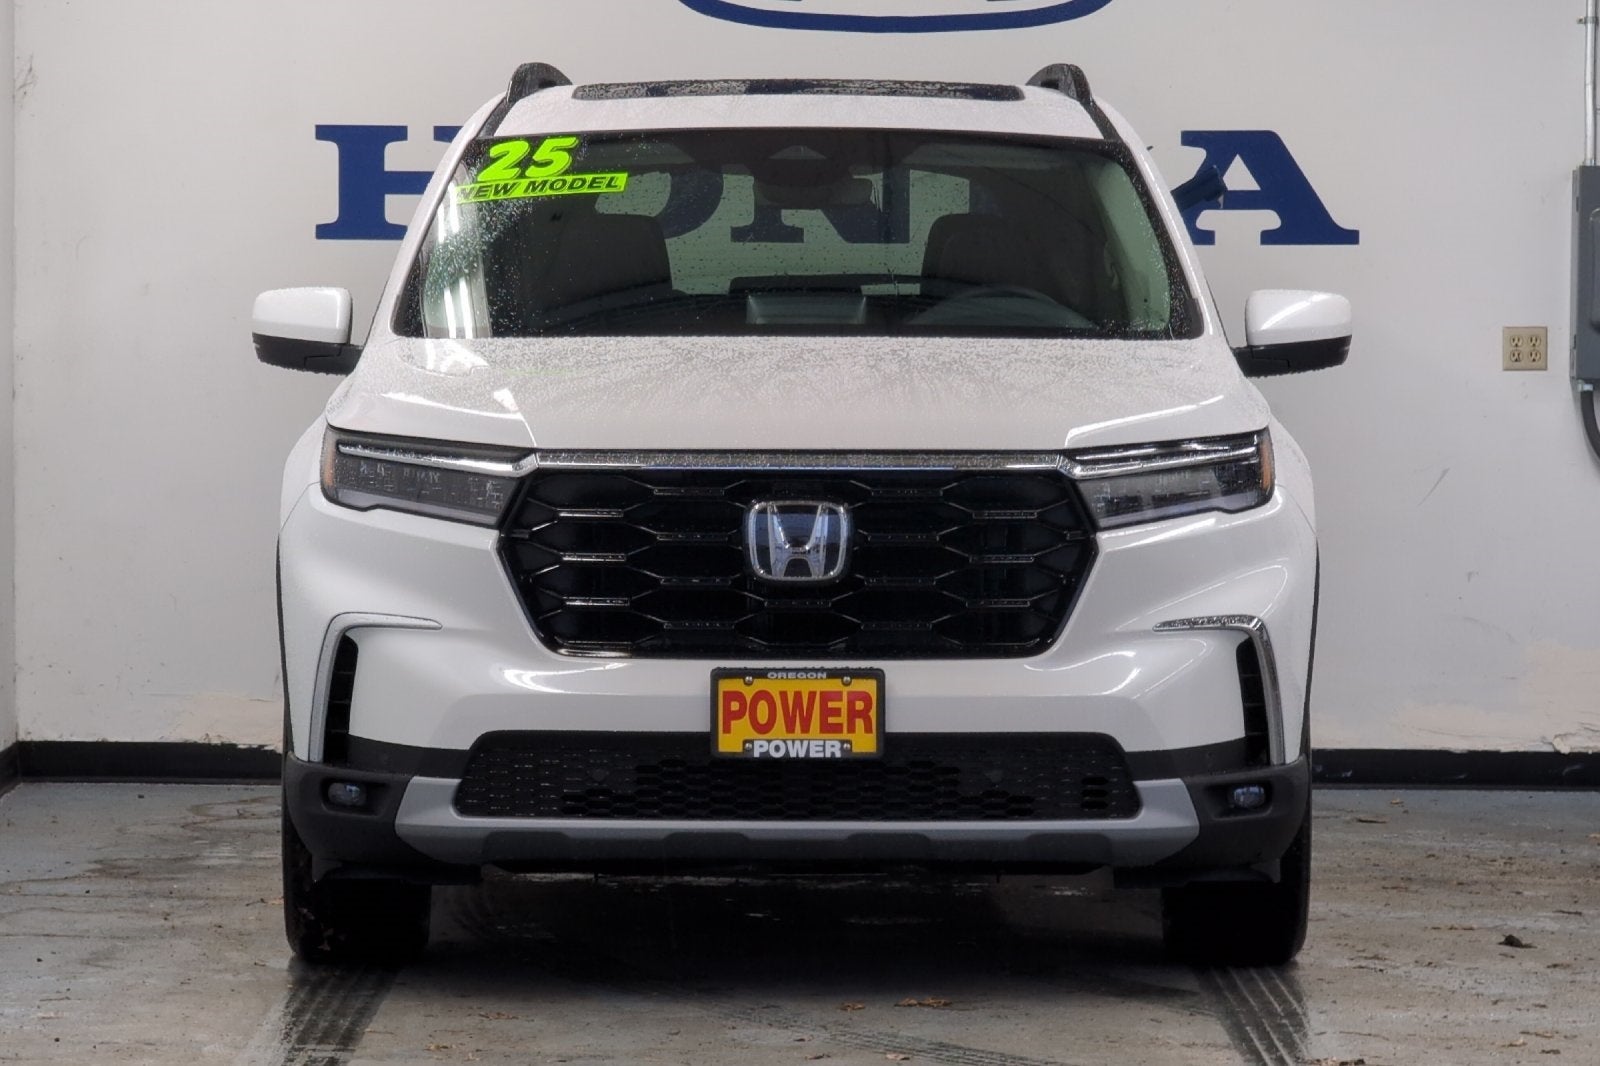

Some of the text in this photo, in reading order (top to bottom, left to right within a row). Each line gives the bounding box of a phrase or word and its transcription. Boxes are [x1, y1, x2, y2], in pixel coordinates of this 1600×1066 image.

[477, 136, 579, 182] 25
[315, 125, 1359, 246] HNA
[456, 175, 621, 200] NEW MODEL
[767, 671, 827, 680] OREGON
[722, 689, 873, 735] POWER
[753, 739, 842, 759] POWER
